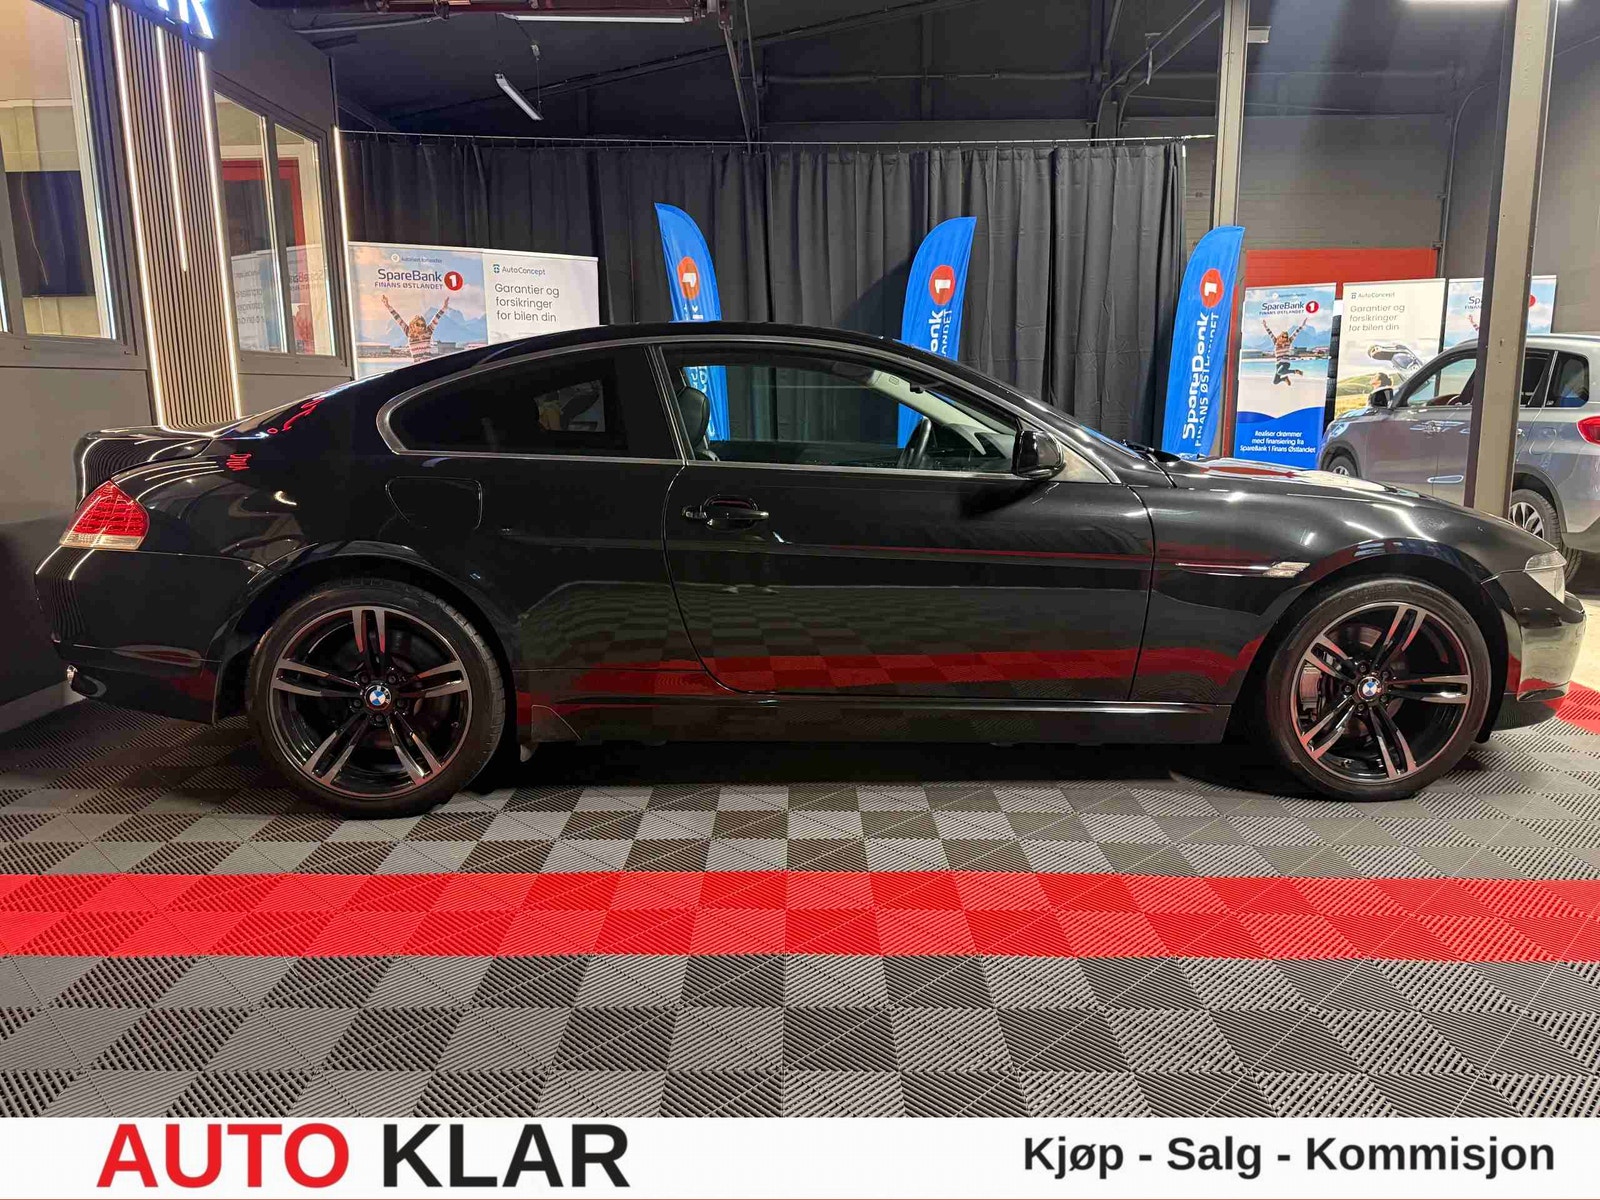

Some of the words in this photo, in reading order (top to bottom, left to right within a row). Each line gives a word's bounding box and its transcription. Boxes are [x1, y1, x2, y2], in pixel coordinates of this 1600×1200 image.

[377, 268, 443, 282] SpareBank
[501, 265, 546, 276] AutoConcept
[374, 281, 401, 289] FINANS
[402, 282, 444, 291] ØSTLANDET
[494, 283, 544, 295] Garantier
[545, 287, 560, 298] og
[495, 296, 552, 310] forsikringer
[1261, 301, 1305, 311] SpareBank
[1350, 305, 1391, 313] Garantier
[1392, 305, 1406, 313] og
[496, 310, 511, 321] for
[513, 310, 539, 321] bilen
[541, 311, 557, 322] din
[1349, 314, 1398, 324] forsikringer
[1348, 324, 1361, 332] for
[1362, 323, 1384, 331] bilen
[1385, 323, 1400, 331] din
